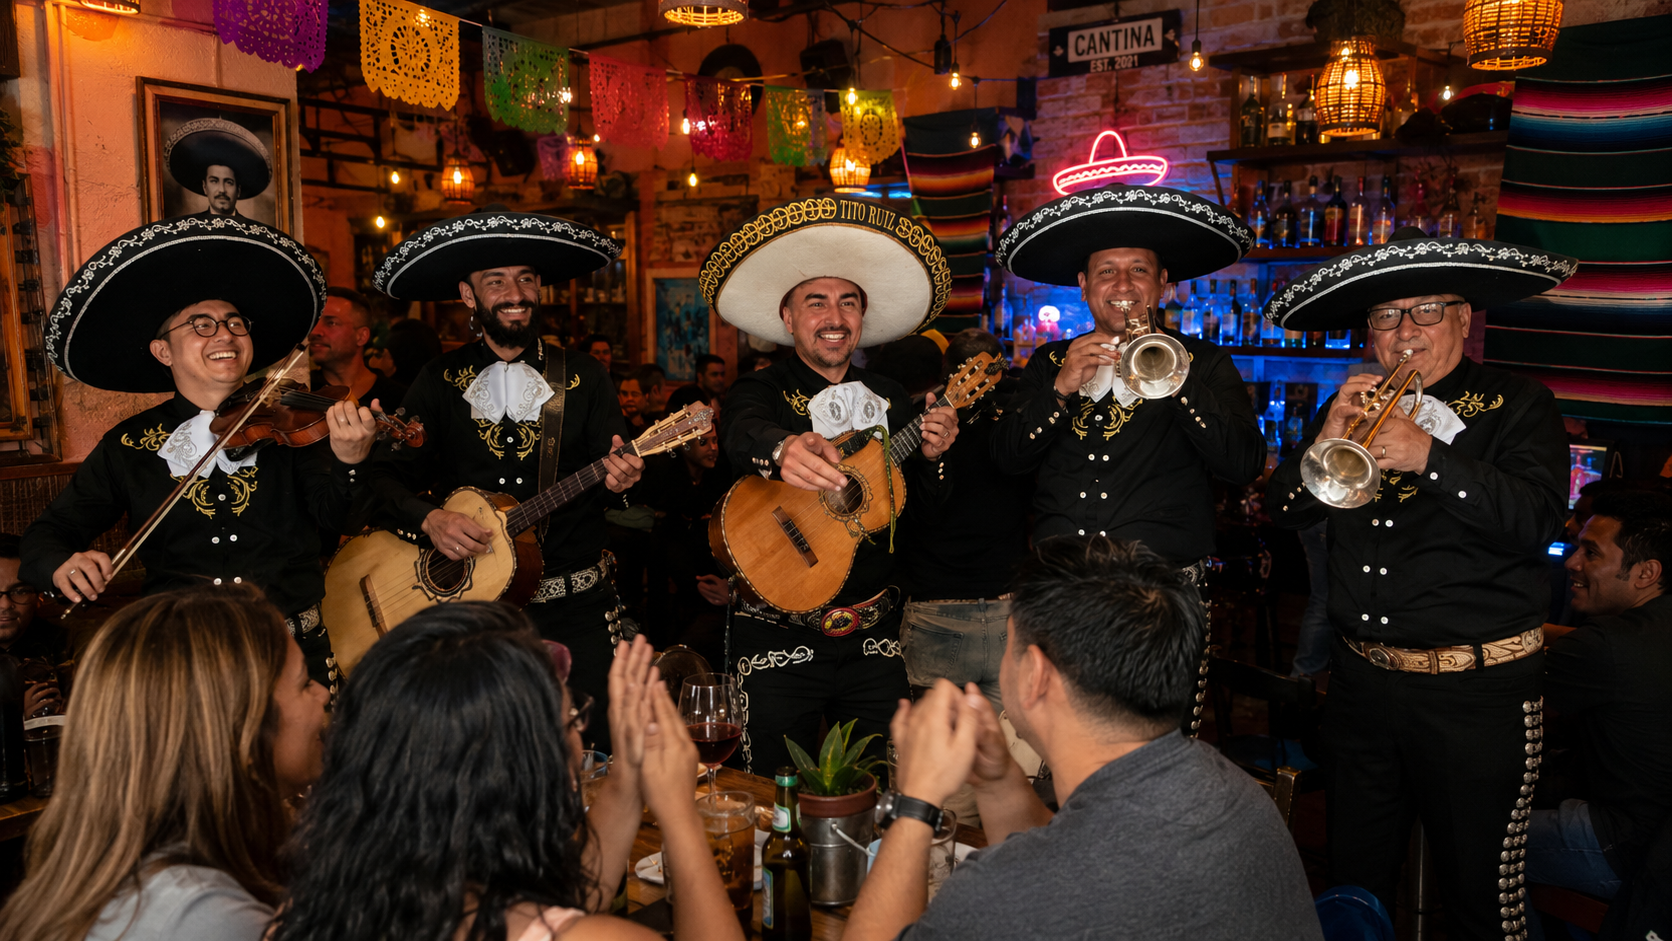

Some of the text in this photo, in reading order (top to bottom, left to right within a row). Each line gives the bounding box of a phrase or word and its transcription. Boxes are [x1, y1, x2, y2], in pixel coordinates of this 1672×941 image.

[1074, 25, 1155, 57] CANTINA
[1090, 55, 1138, 73] EST. 2021
[840, 199, 896, 231] TITO RUIZ
